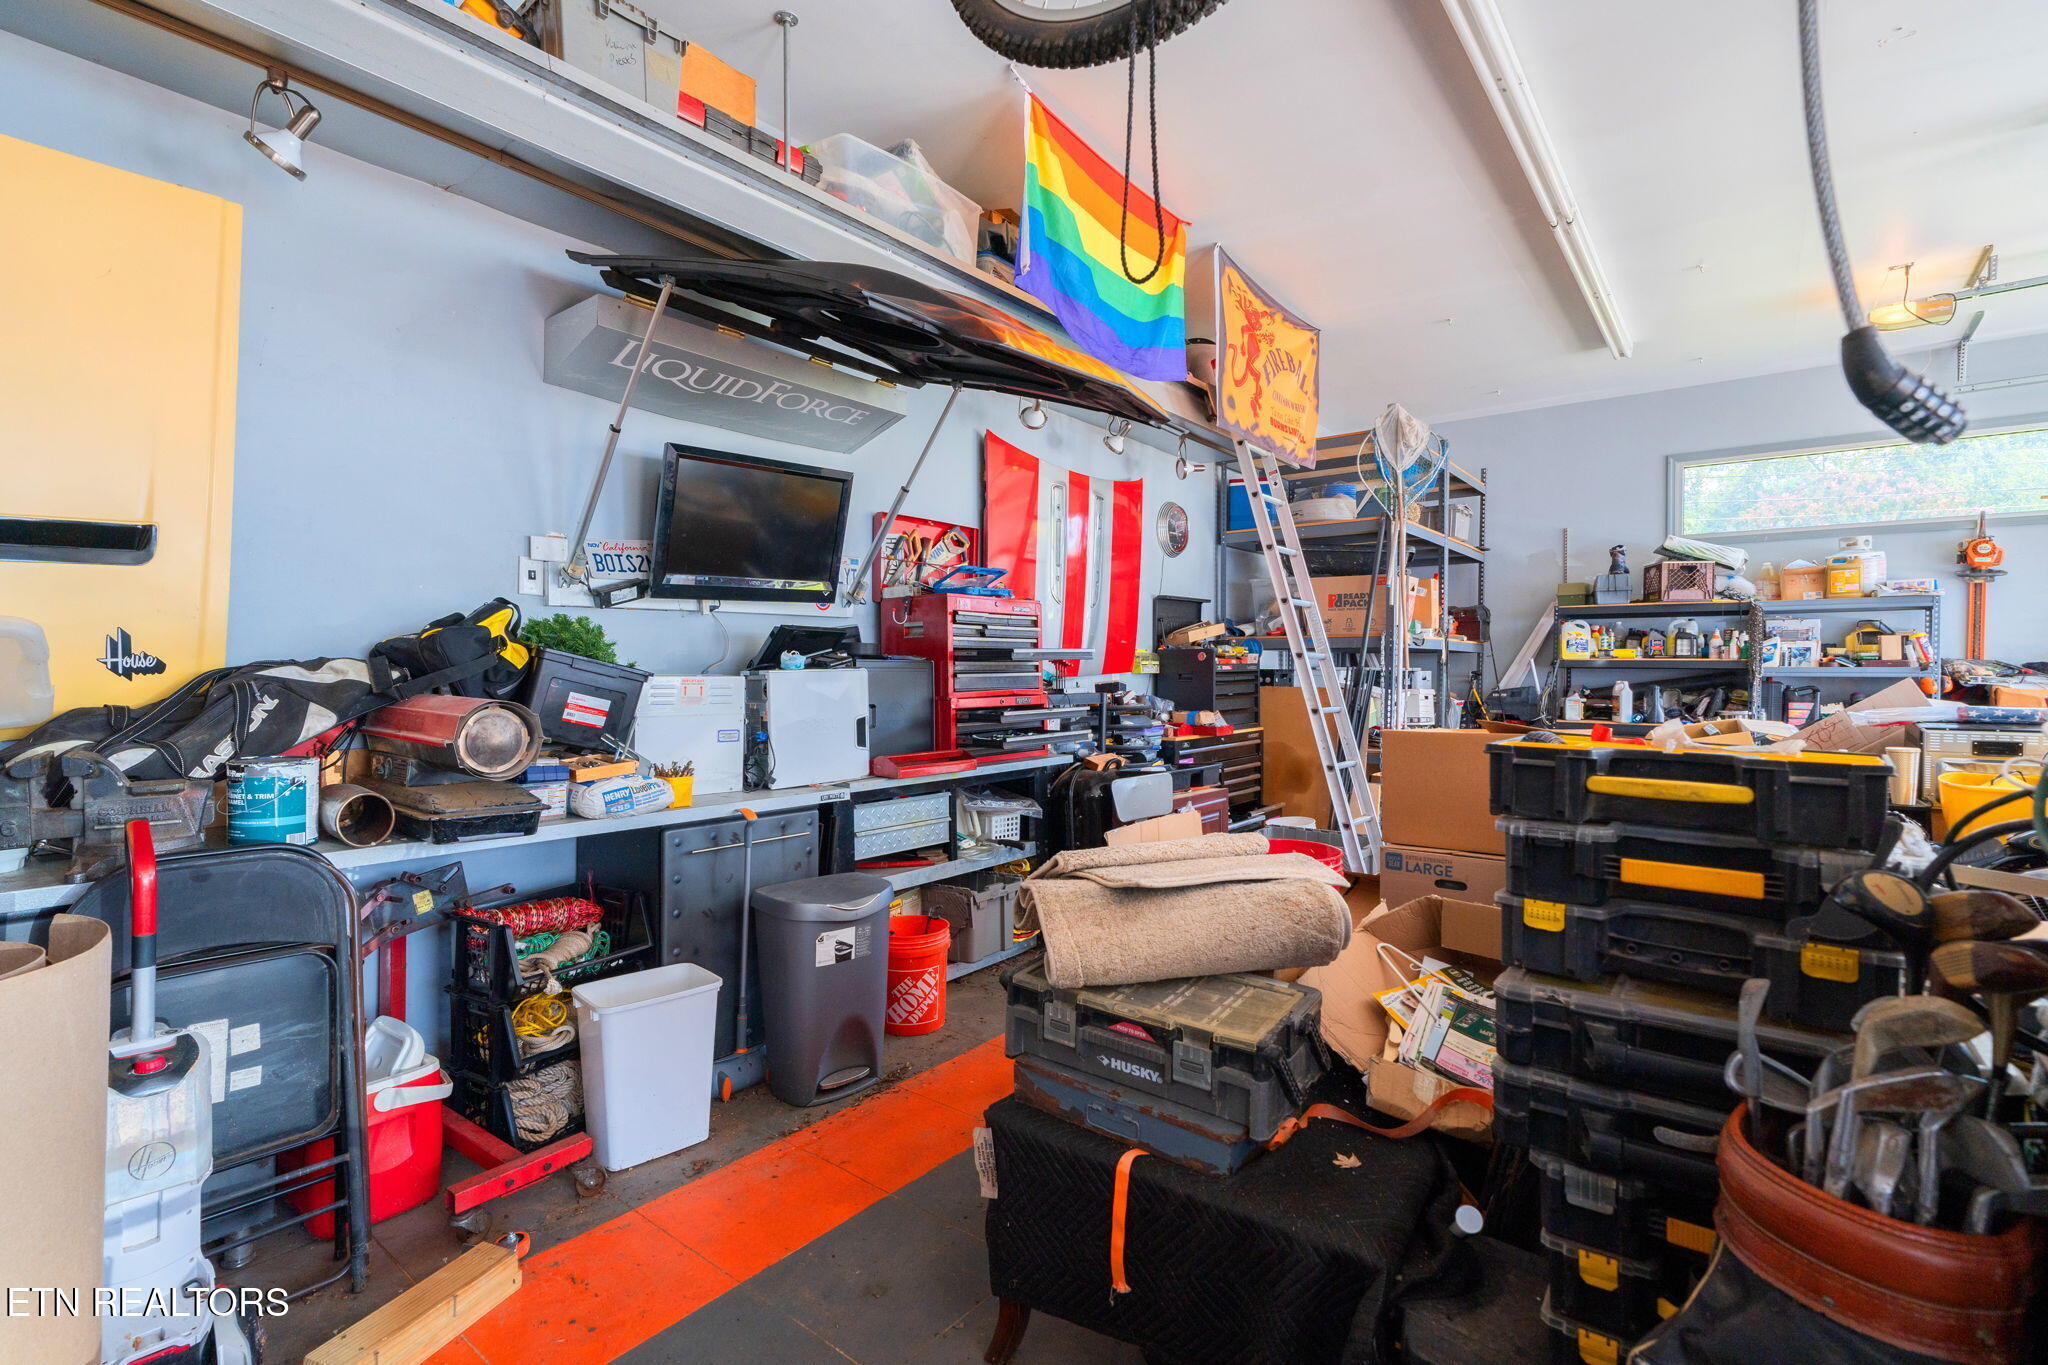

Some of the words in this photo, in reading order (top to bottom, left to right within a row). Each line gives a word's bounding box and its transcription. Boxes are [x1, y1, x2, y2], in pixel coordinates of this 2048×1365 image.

[96, 627, 157, 674] House
[603, 788, 631, 802] HENRY
[1405, 861, 1453, 878] LARGE
[887, 968, 938, 1024] HOME
[891, 976, 916, 998] THE
[907, 986, 939, 1024] DEPOT
[1110, 1057, 1160, 1083] HUSKY
